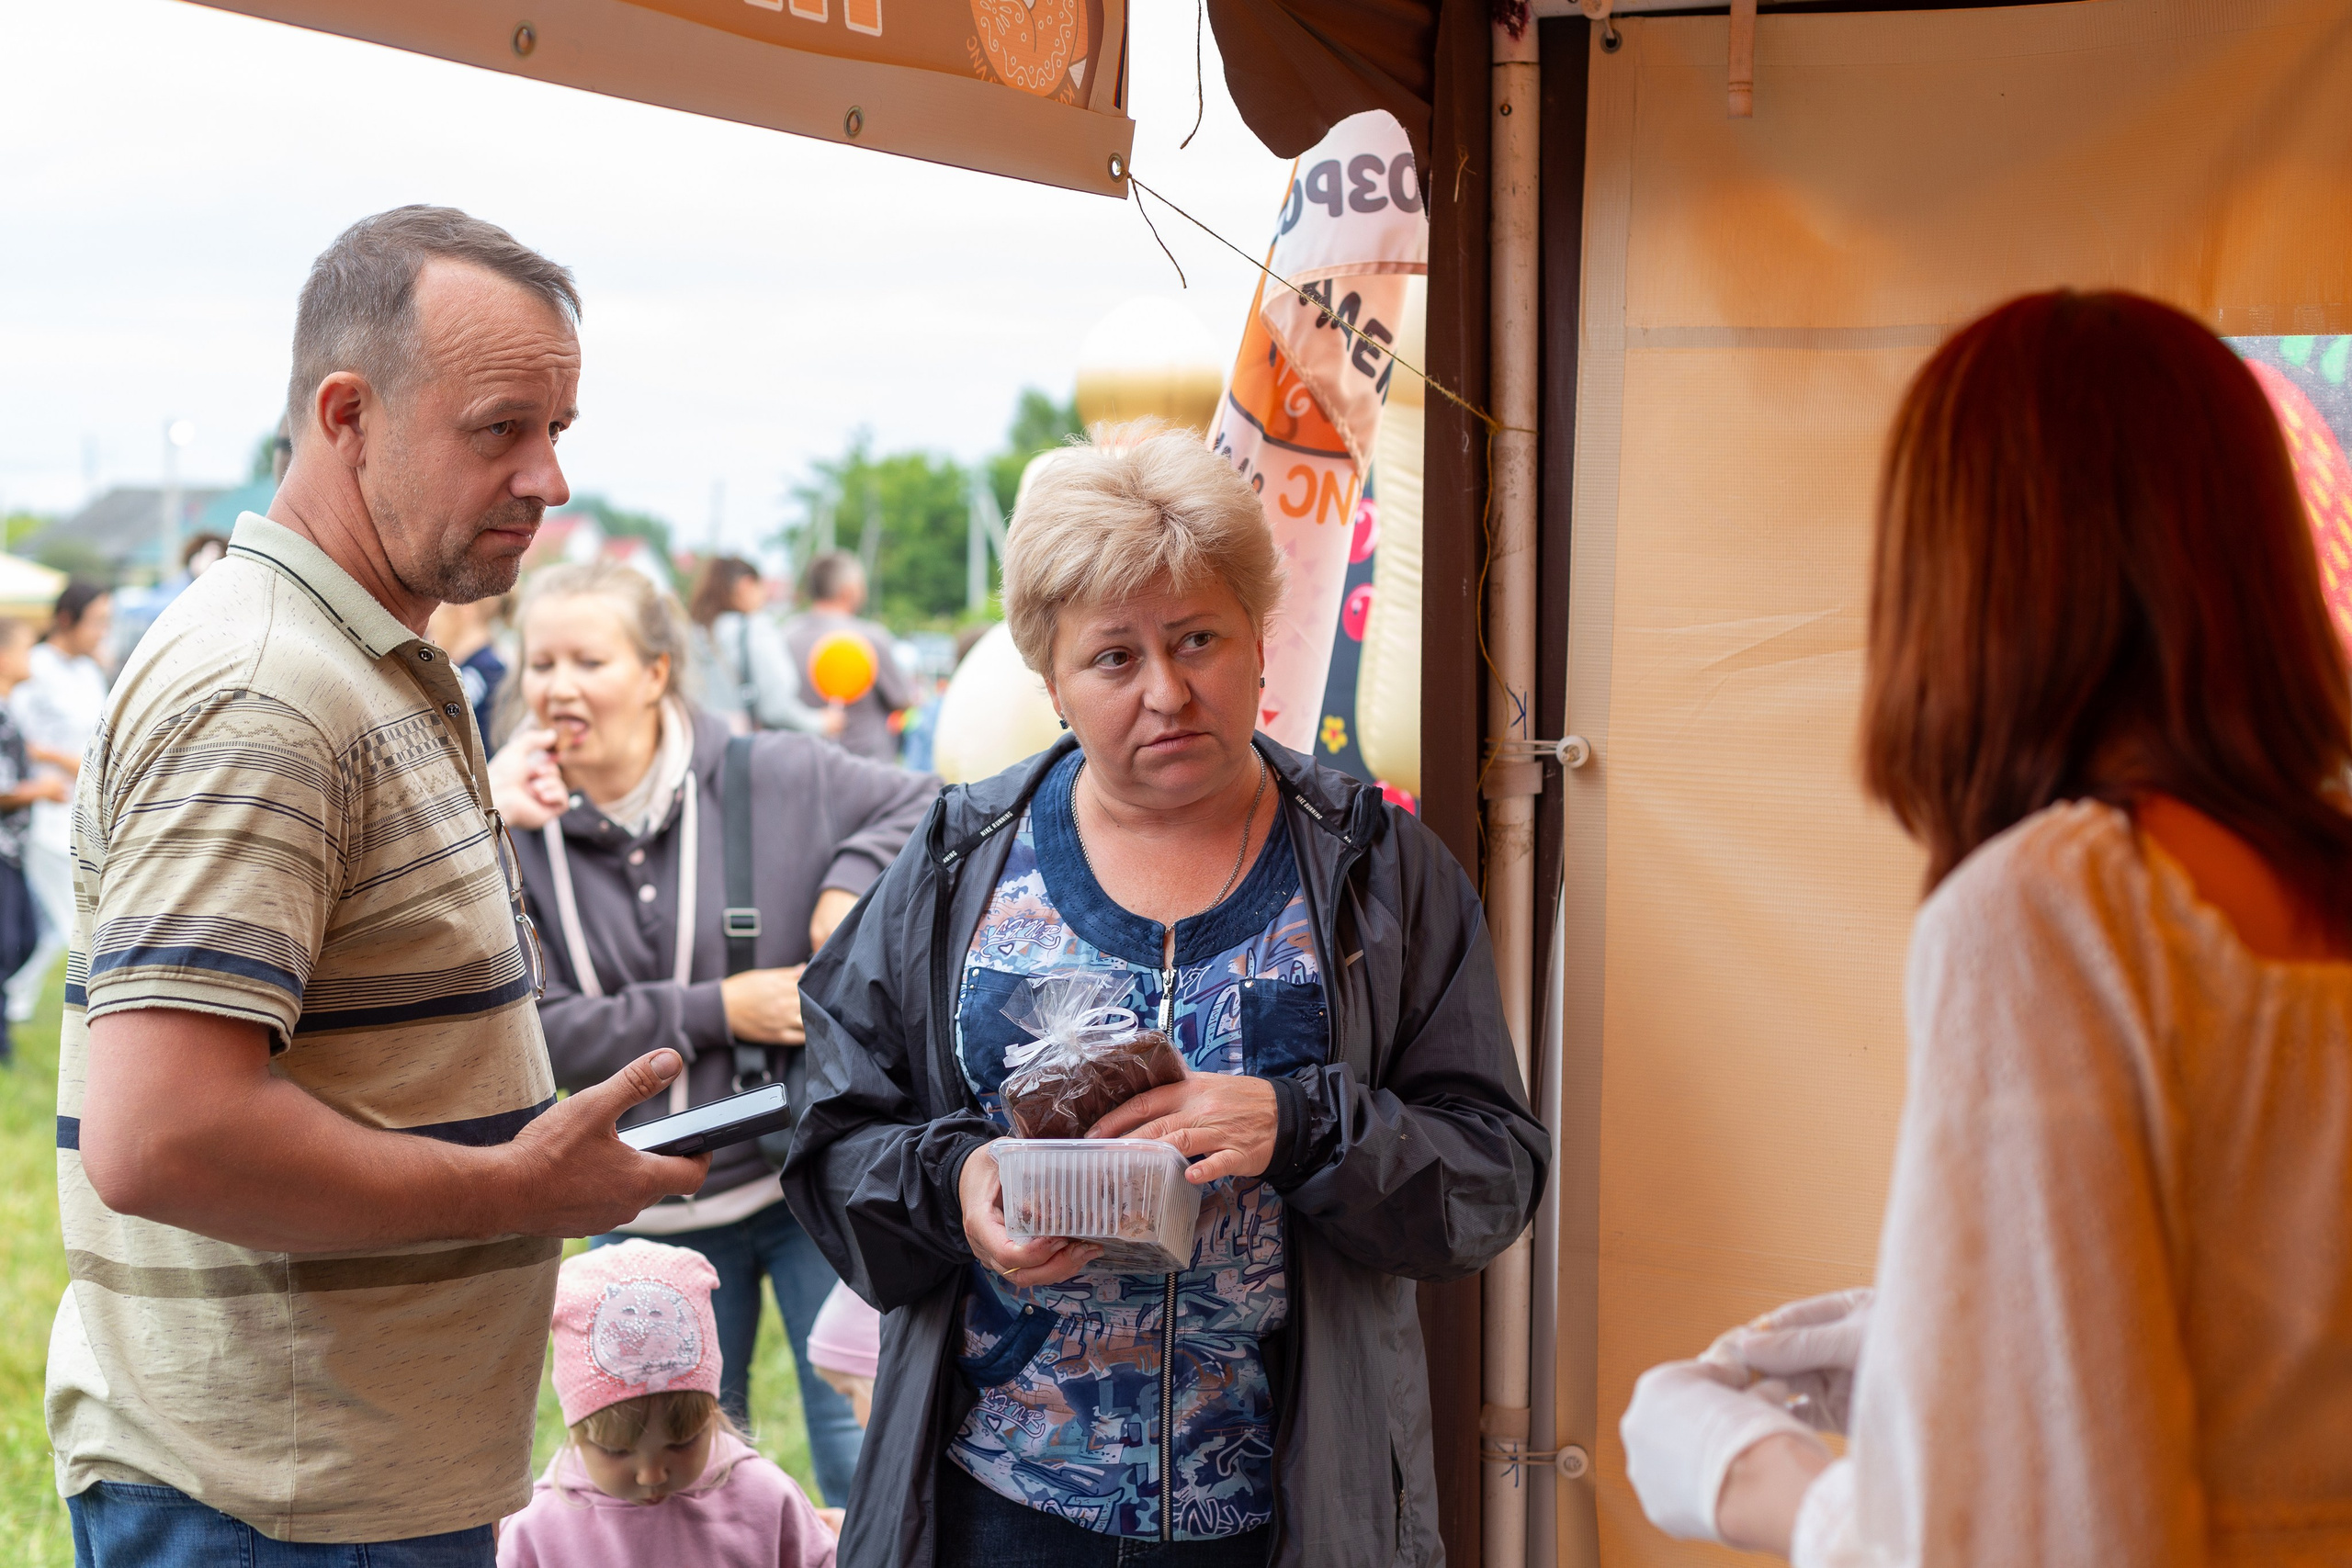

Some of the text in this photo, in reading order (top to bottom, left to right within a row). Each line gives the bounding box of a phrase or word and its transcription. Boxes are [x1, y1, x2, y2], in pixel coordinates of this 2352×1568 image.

[1295, 795, 1323, 820] NIKE RUNNING
[979, 810, 1013, 837] NIKE RUNNING
